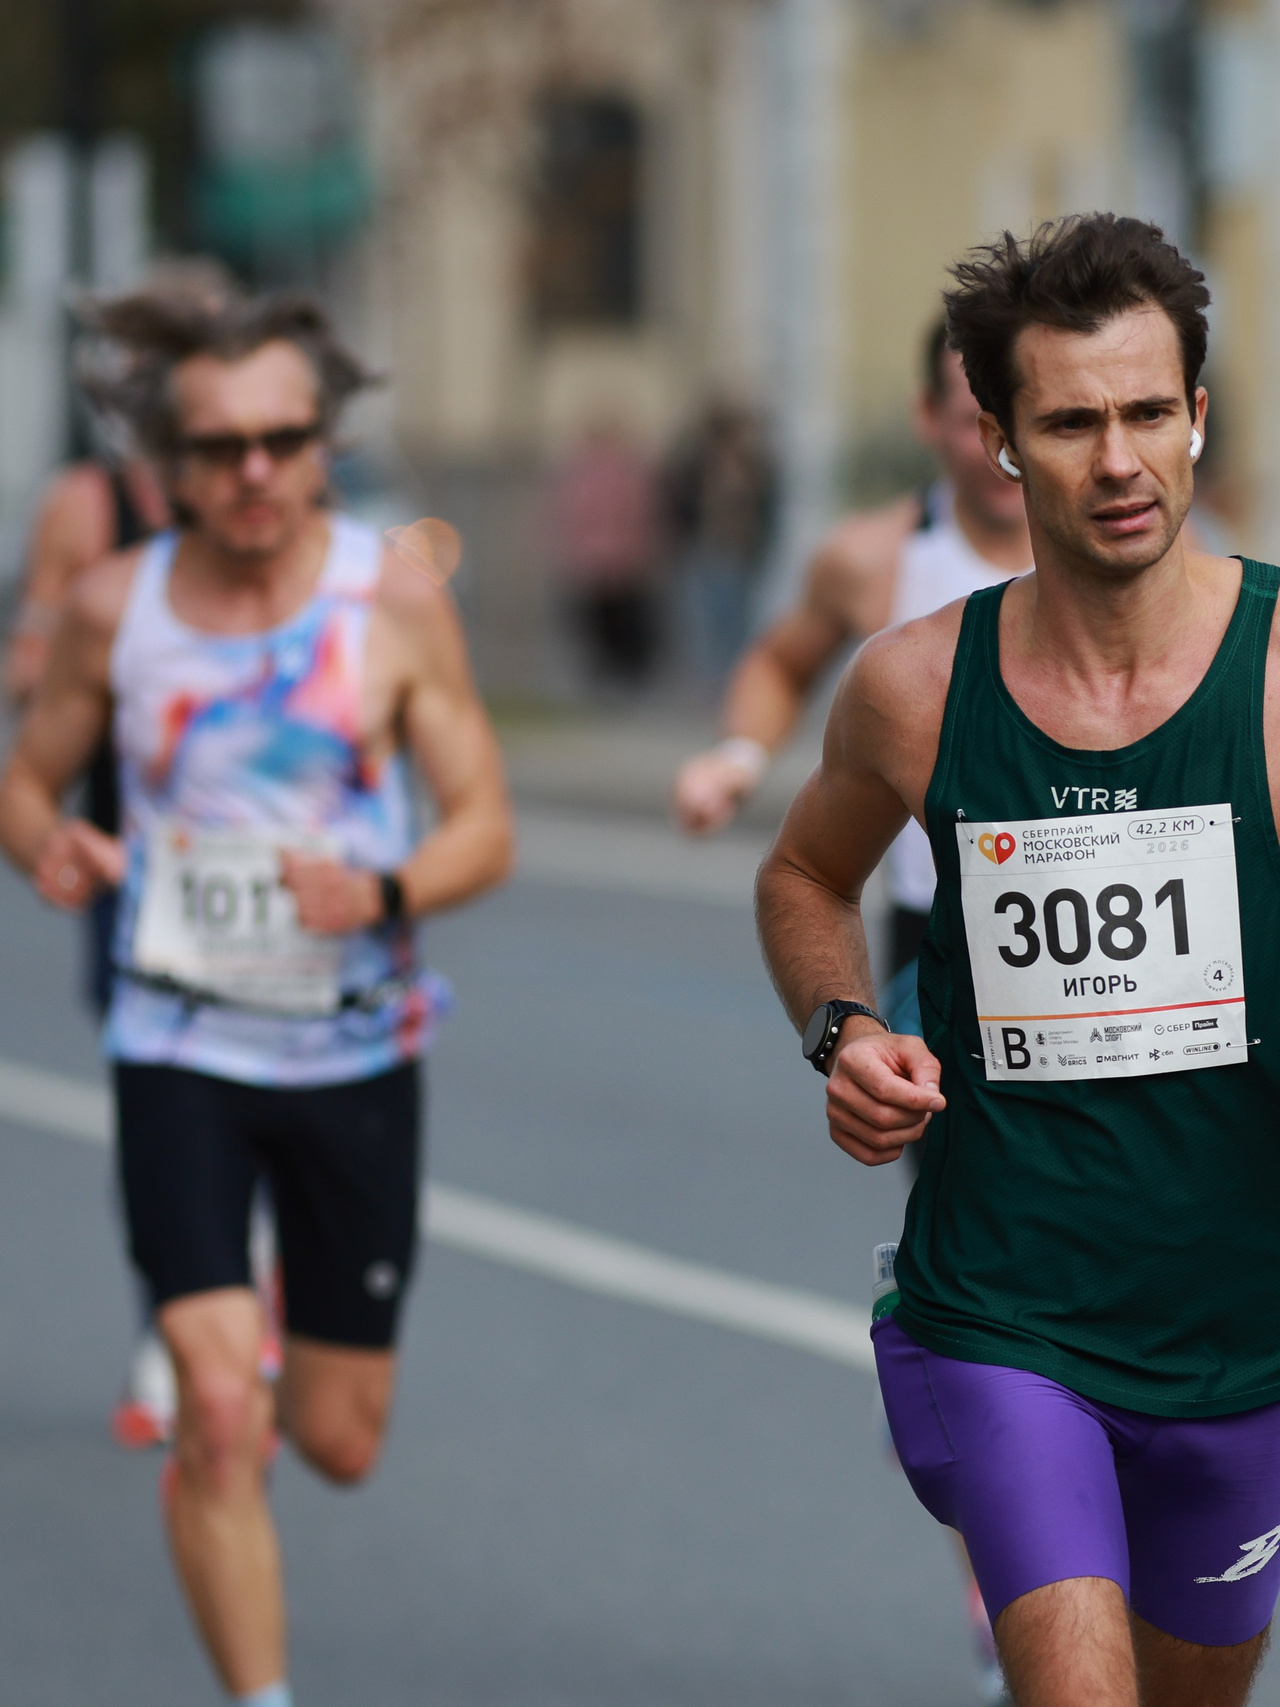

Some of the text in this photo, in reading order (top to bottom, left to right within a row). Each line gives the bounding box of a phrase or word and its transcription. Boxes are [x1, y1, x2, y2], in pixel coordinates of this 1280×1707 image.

[1022, 825, 1094, 840] СБЕРПРАЙМ
[1136, 821, 1167, 837] 42,2
[1023, 833, 1121, 852] МОСКОВСКИЙ
[1146, 839, 1190, 855] 2026
[1024, 849, 1096, 865] МАРАФОН
[993, 878, 1191, 968] 3081
[1213, 969, 1224, 981] 4
[1063, 974, 1138, 998] ИГОРЬ
[1104, 1022, 1143, 1034] МОСКОВСКИЙ
[1166, 1023, 1190, 1033] СБЕР
[1105, 1033, 1123, 1042] СПОРТ
[1185, 1044, 1213, 1054] WINLINE
